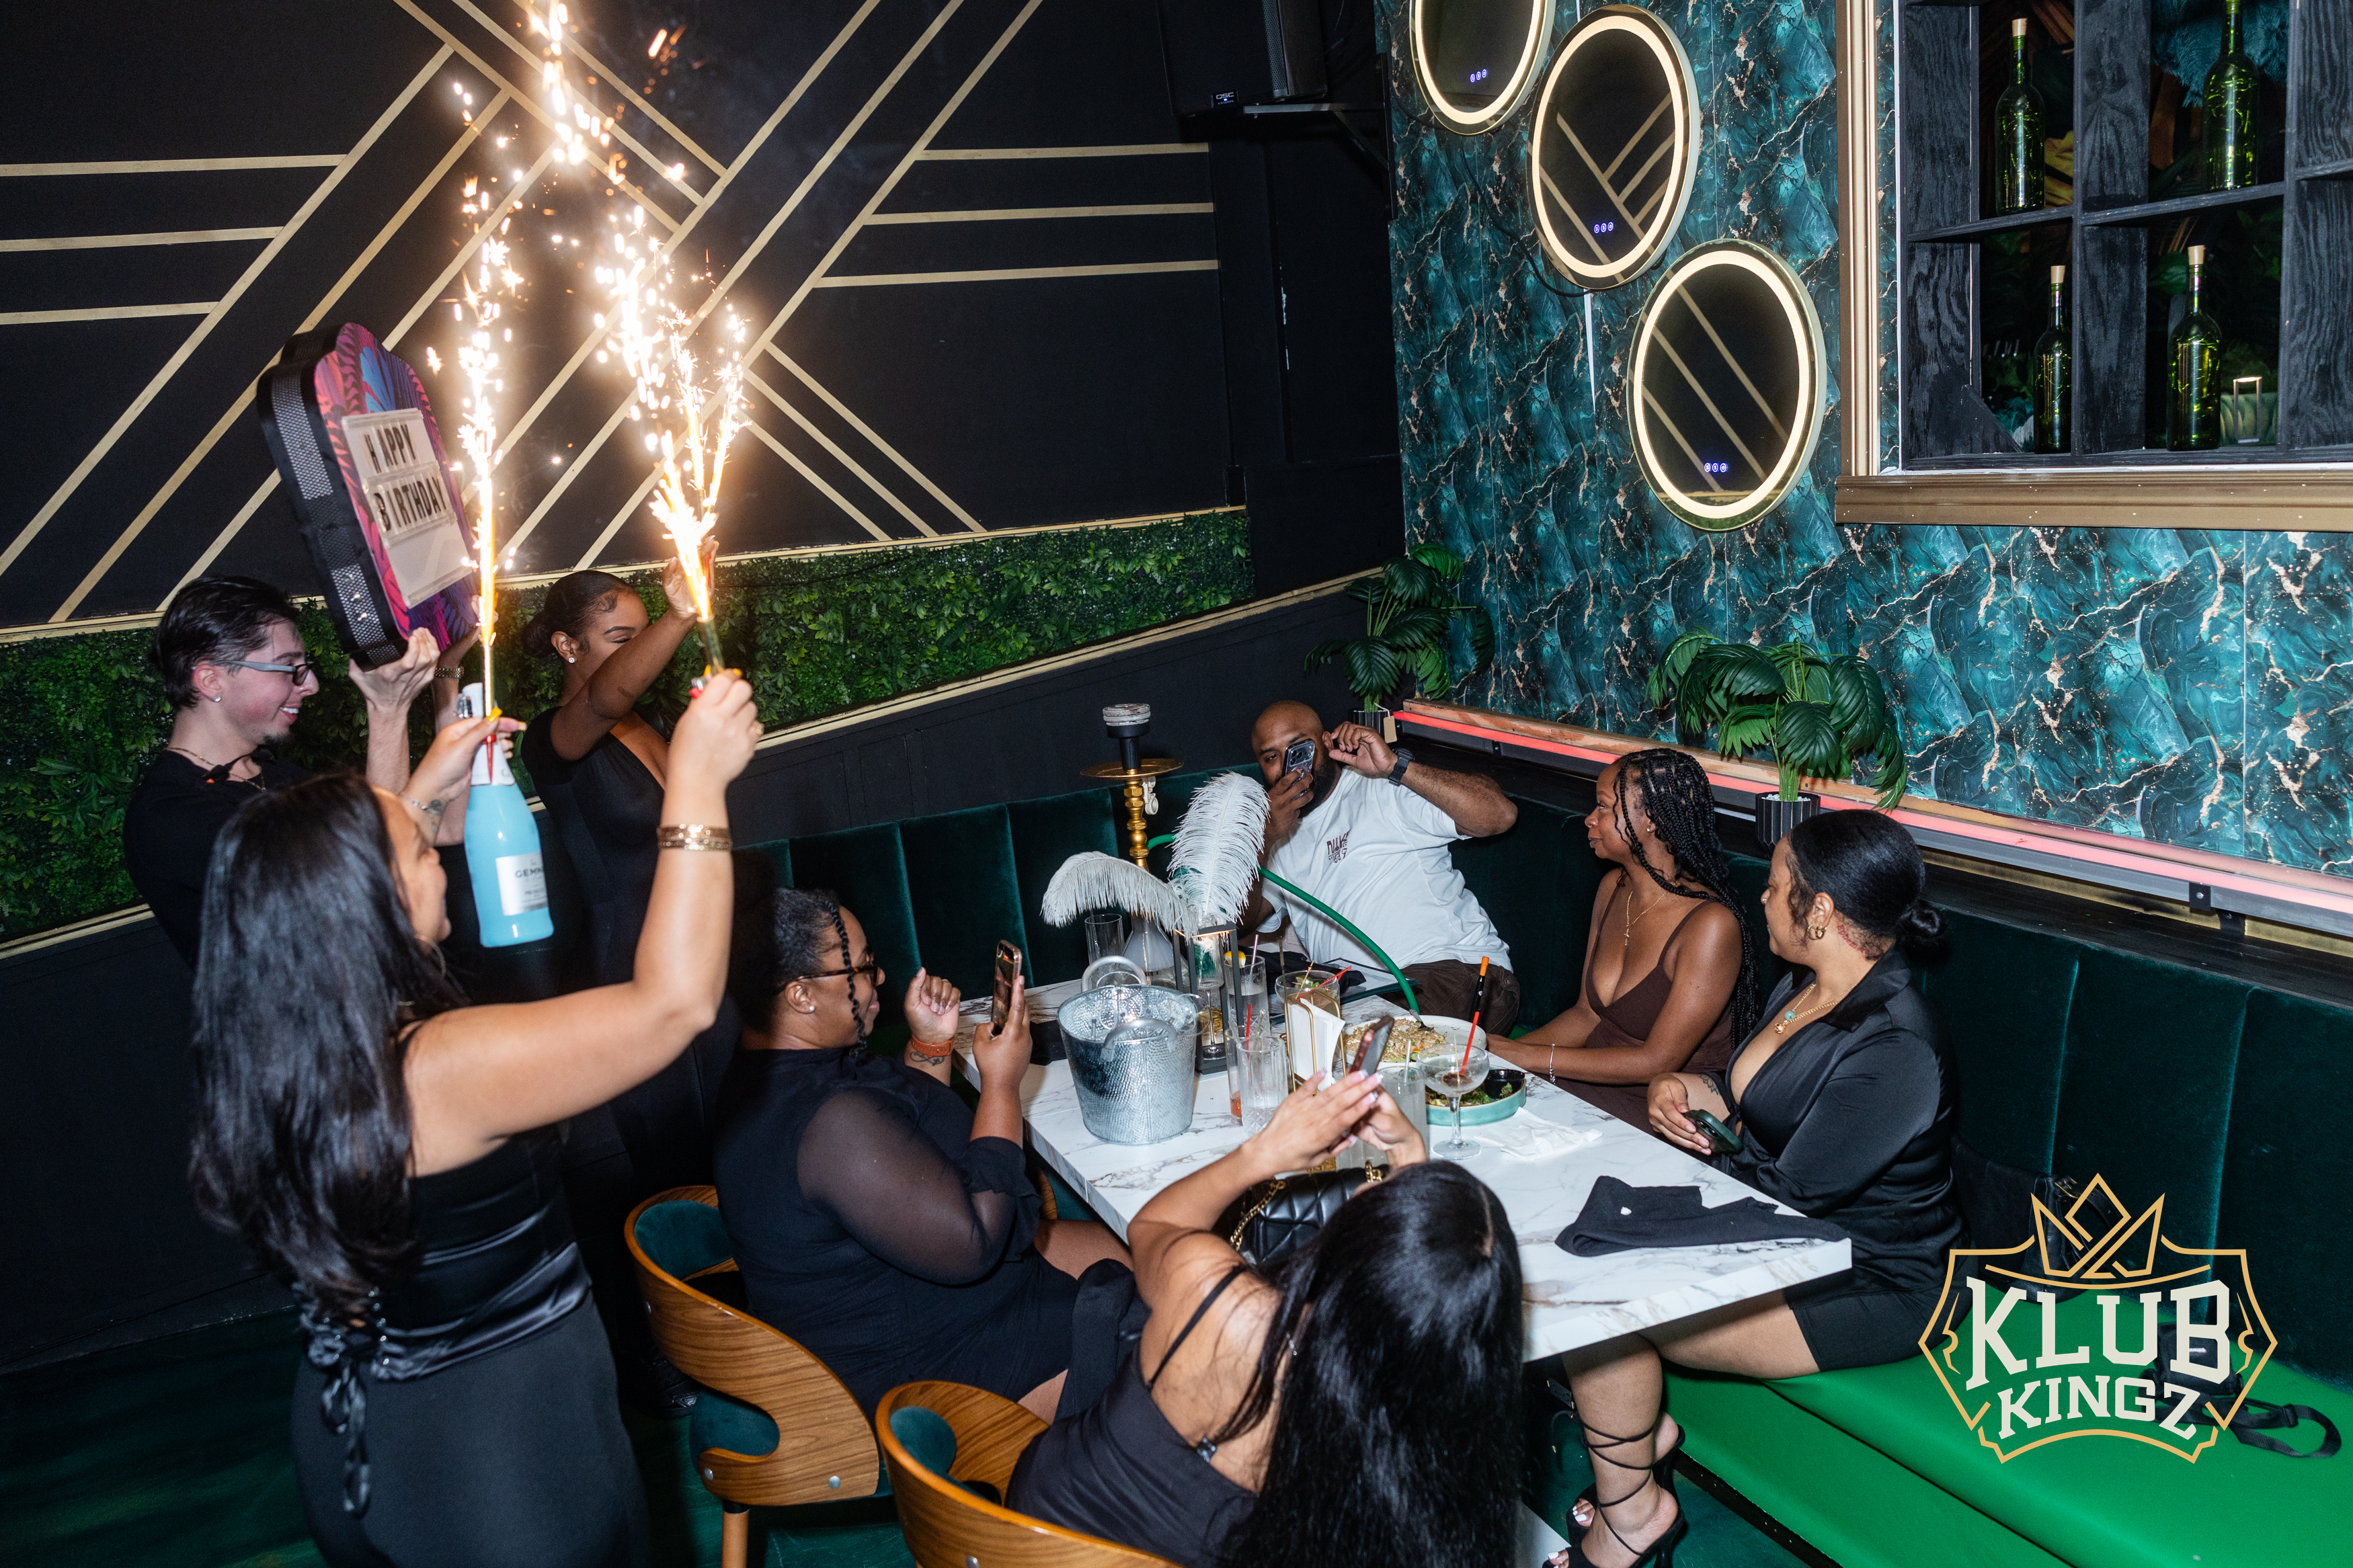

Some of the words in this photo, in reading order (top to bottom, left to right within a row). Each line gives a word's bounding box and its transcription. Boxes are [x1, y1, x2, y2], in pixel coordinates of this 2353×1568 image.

[1215, 91, 1234, 99] QSC
[364, 424, 416, 474] HAPPY
[374, 475, 447, 532] BIRTHDAY
